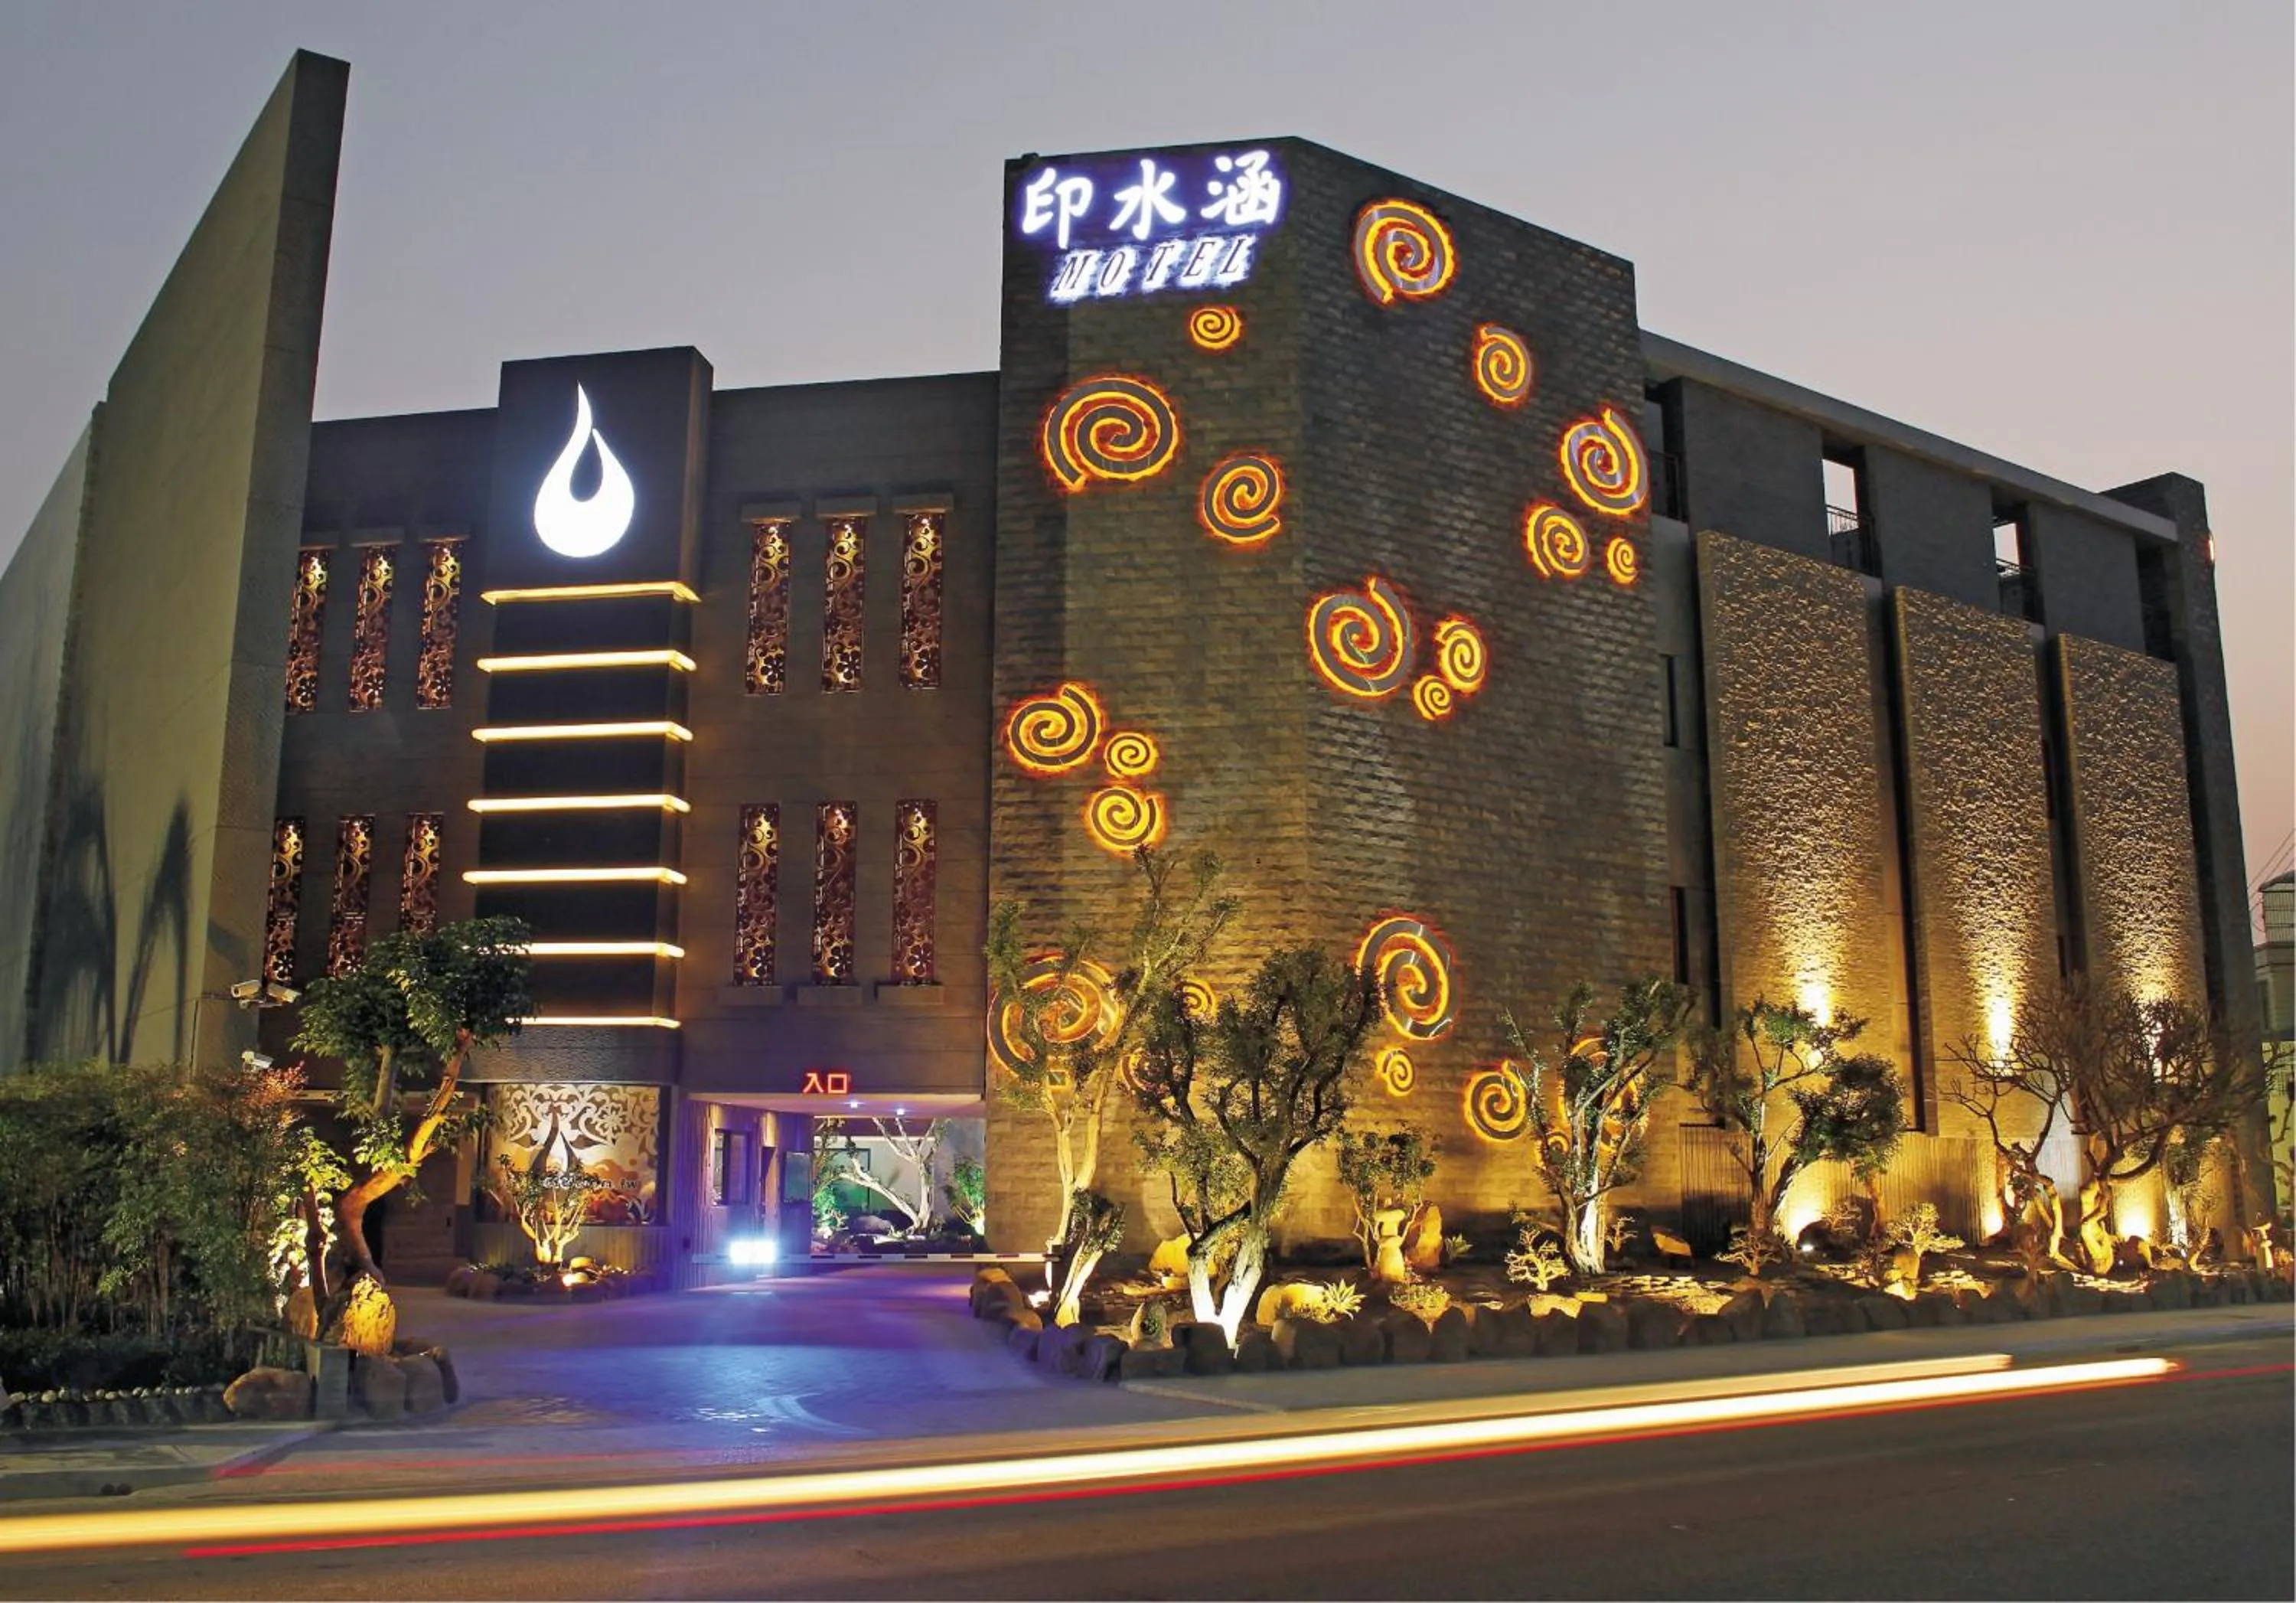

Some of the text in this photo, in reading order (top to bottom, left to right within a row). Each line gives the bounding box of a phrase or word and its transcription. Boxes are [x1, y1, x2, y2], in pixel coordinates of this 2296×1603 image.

[1022, 150, 1282, 250] 印水涵
[1051, 237, 1252, 295] MOTEL
[802, 1072, 848, 1094] 入口
